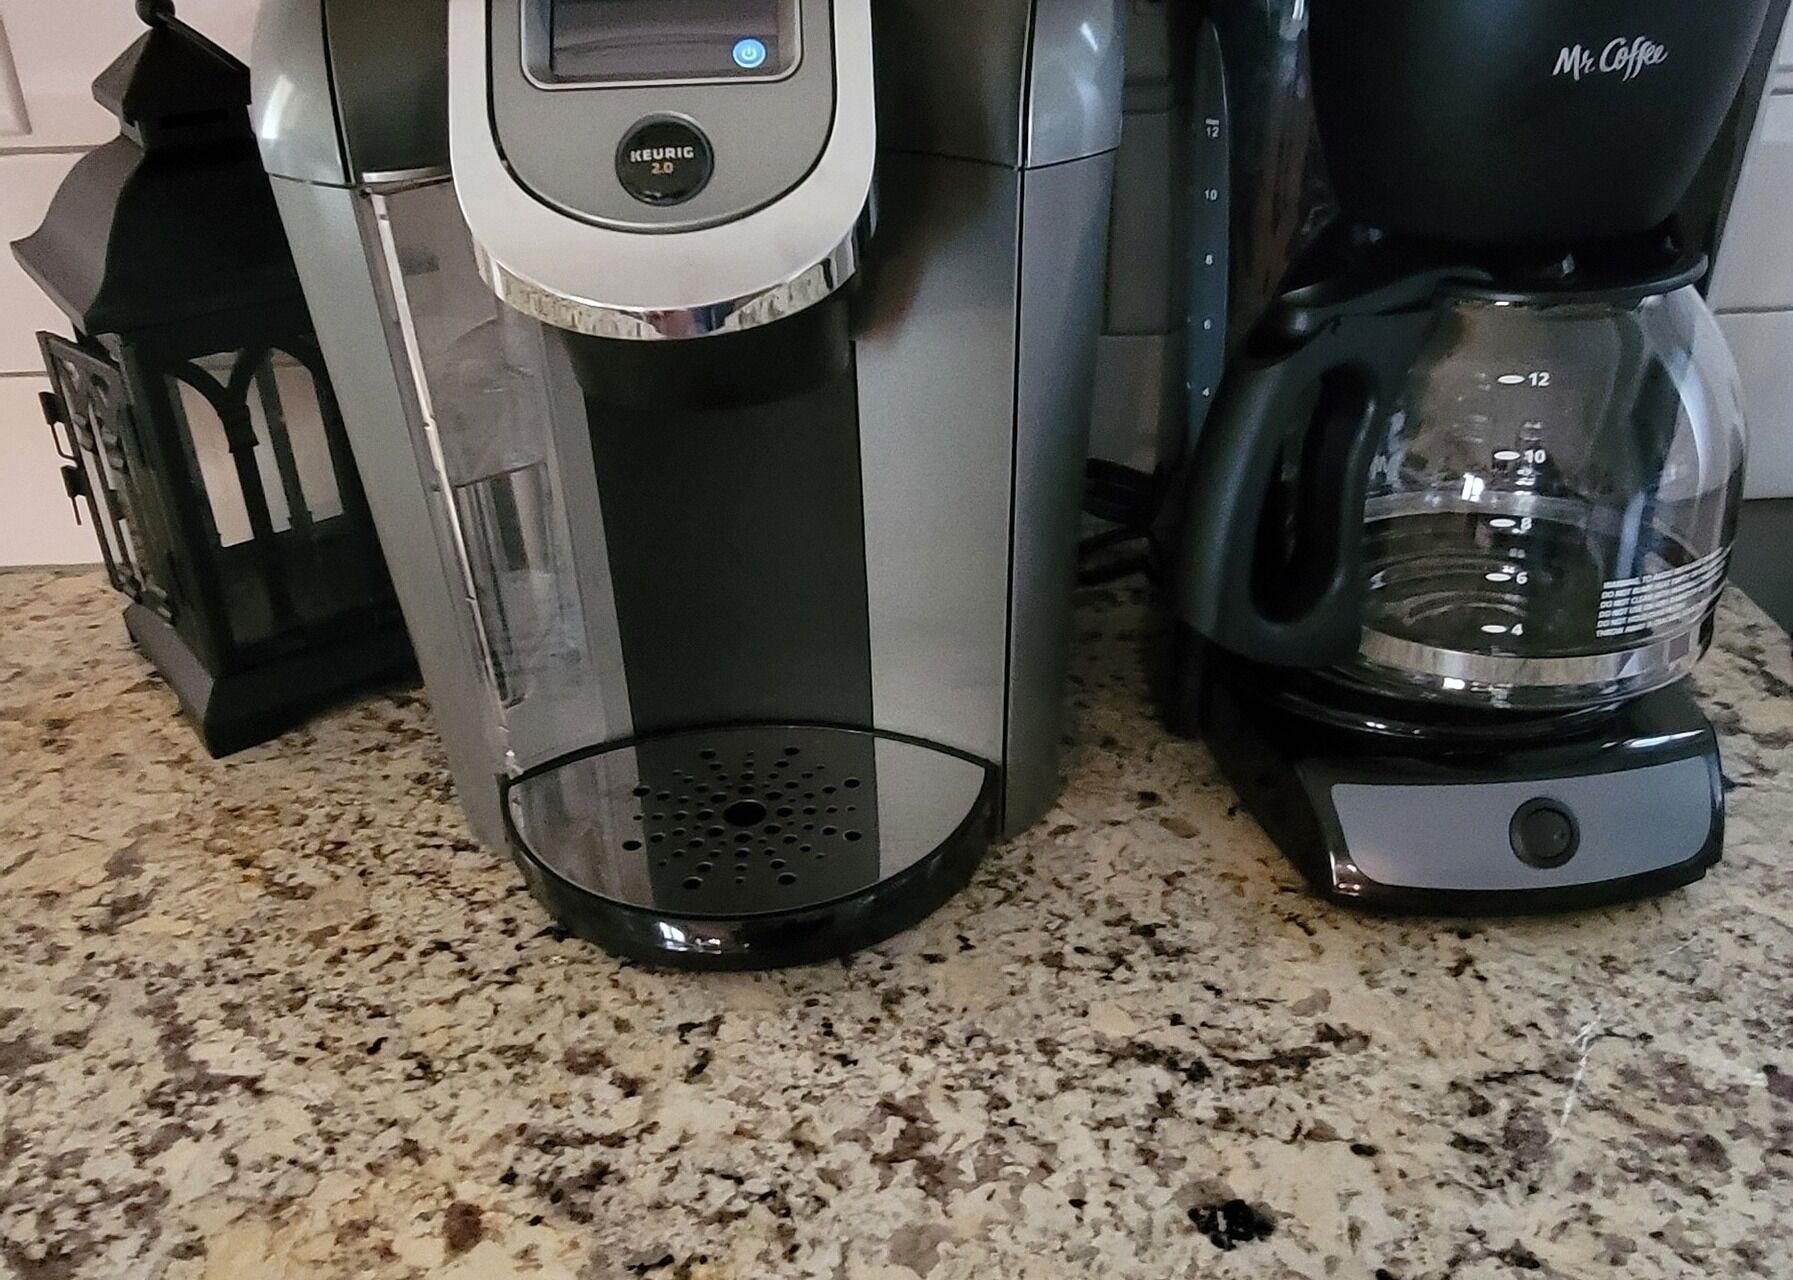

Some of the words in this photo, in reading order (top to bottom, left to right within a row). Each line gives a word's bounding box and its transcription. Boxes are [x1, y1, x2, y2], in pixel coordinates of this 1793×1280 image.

[1599, 36, 1669, 81] Coffee
[1206, 126, 1220, 137] 12
[630, 146, 695, 163] KEURIG
[651, 162, 674, 174] 2.0
[1204, 189, 1218, 201] 10
[1205, 254, 1214, 266] 8
[1204, 319, 1212, 330] 6
[1528, 371, 1551, 387] 12
[1202, 387, 1211, 397] 4
[1523, 449, 1547, 464] 10
[1520, 517, 1533, 530] 8
[1516, 571, 1528, 585] 6
[1511, 623, 1523, 636] 4
